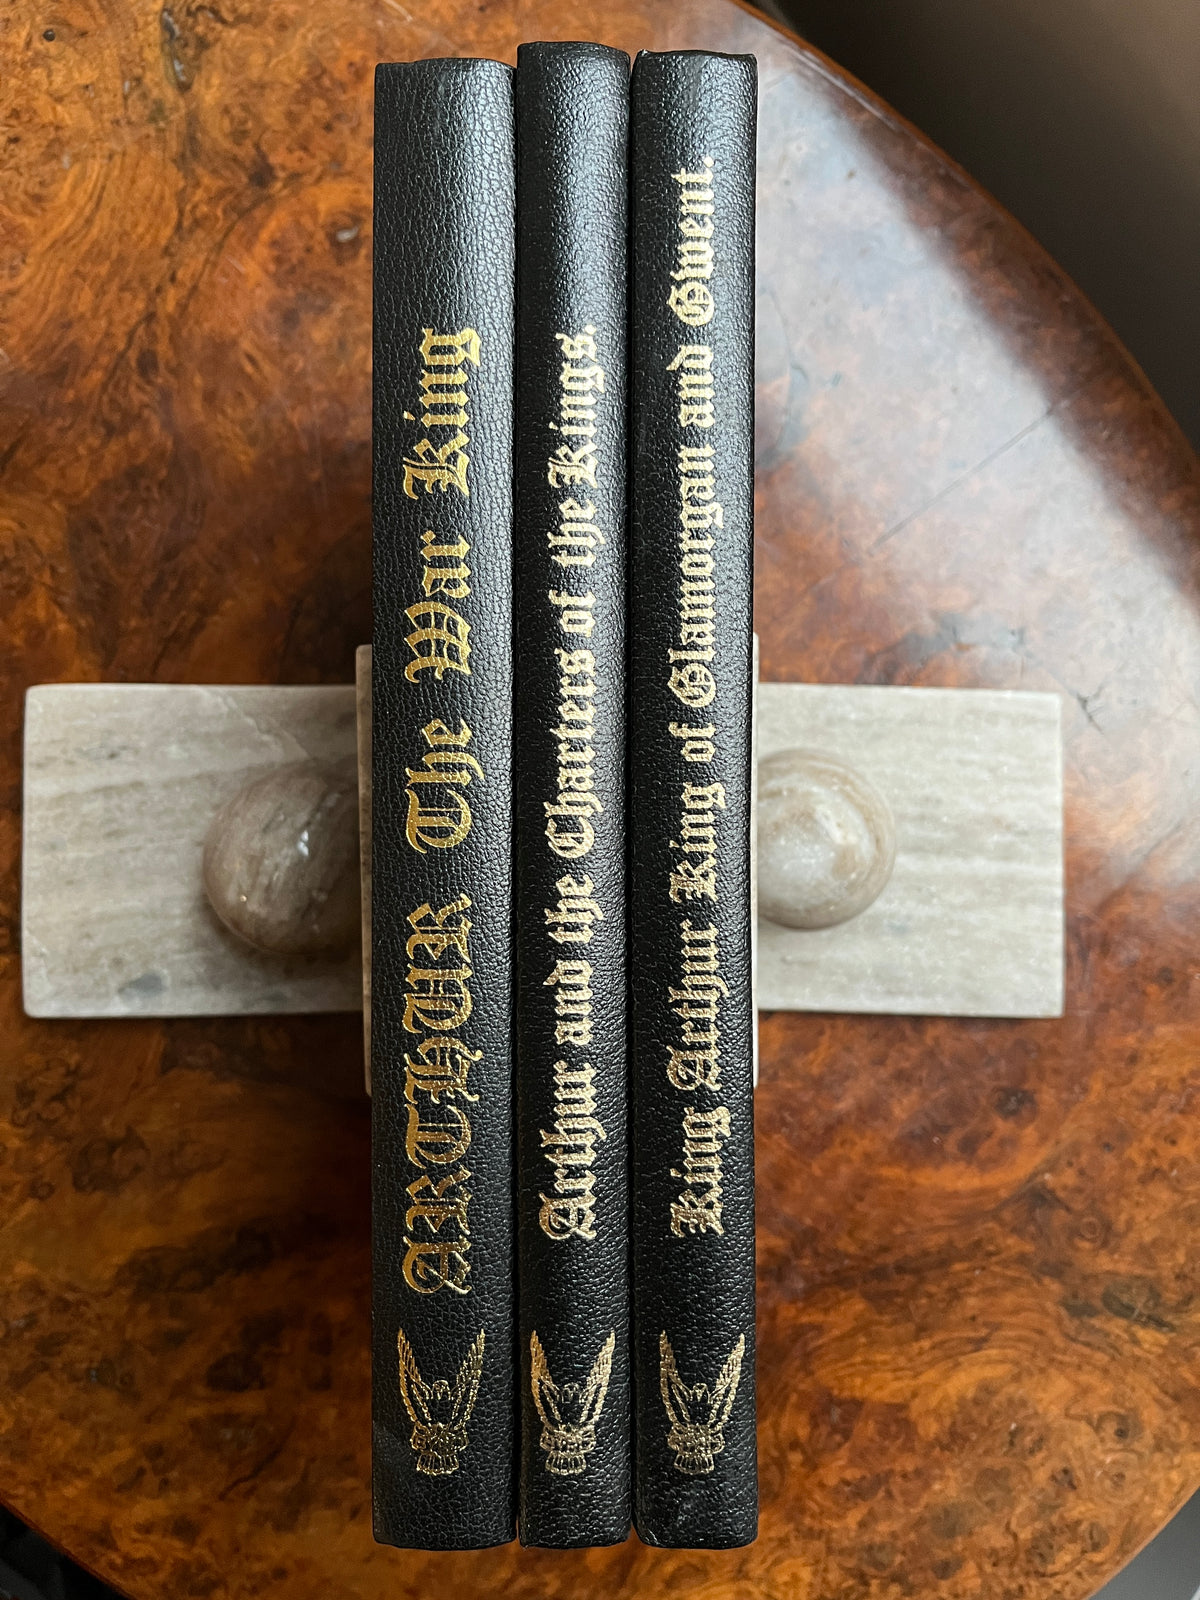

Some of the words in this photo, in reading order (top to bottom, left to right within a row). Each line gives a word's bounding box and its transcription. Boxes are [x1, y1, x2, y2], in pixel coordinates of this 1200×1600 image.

[666, 155, 717, 326] Gwent.
[402, 328, 481, 500] King
[547, 324, 606, 488] Kings.
[666, 344, 715, 428] and
[403, 529, 473, 683] War
[547, 499, 605, 568] the
[666, 444, 723, 709] Glamorgan
[549, 589, 596, 637] of
[405, 717, 486, 854] The
[544, 648, 604, 857] Charters
[668, 722, 717, 762] of
[545, 875, 604, 943] the
[668, 781, 725, 903] King
[545, 959, 595, 1045] and
[665, 919, 730, 1091] Arthur
[402, 893, 483, 1294] ARTHUR
[538, 1061, 606, 1239] Arthur
[669, 1107, 731, 1237] King
